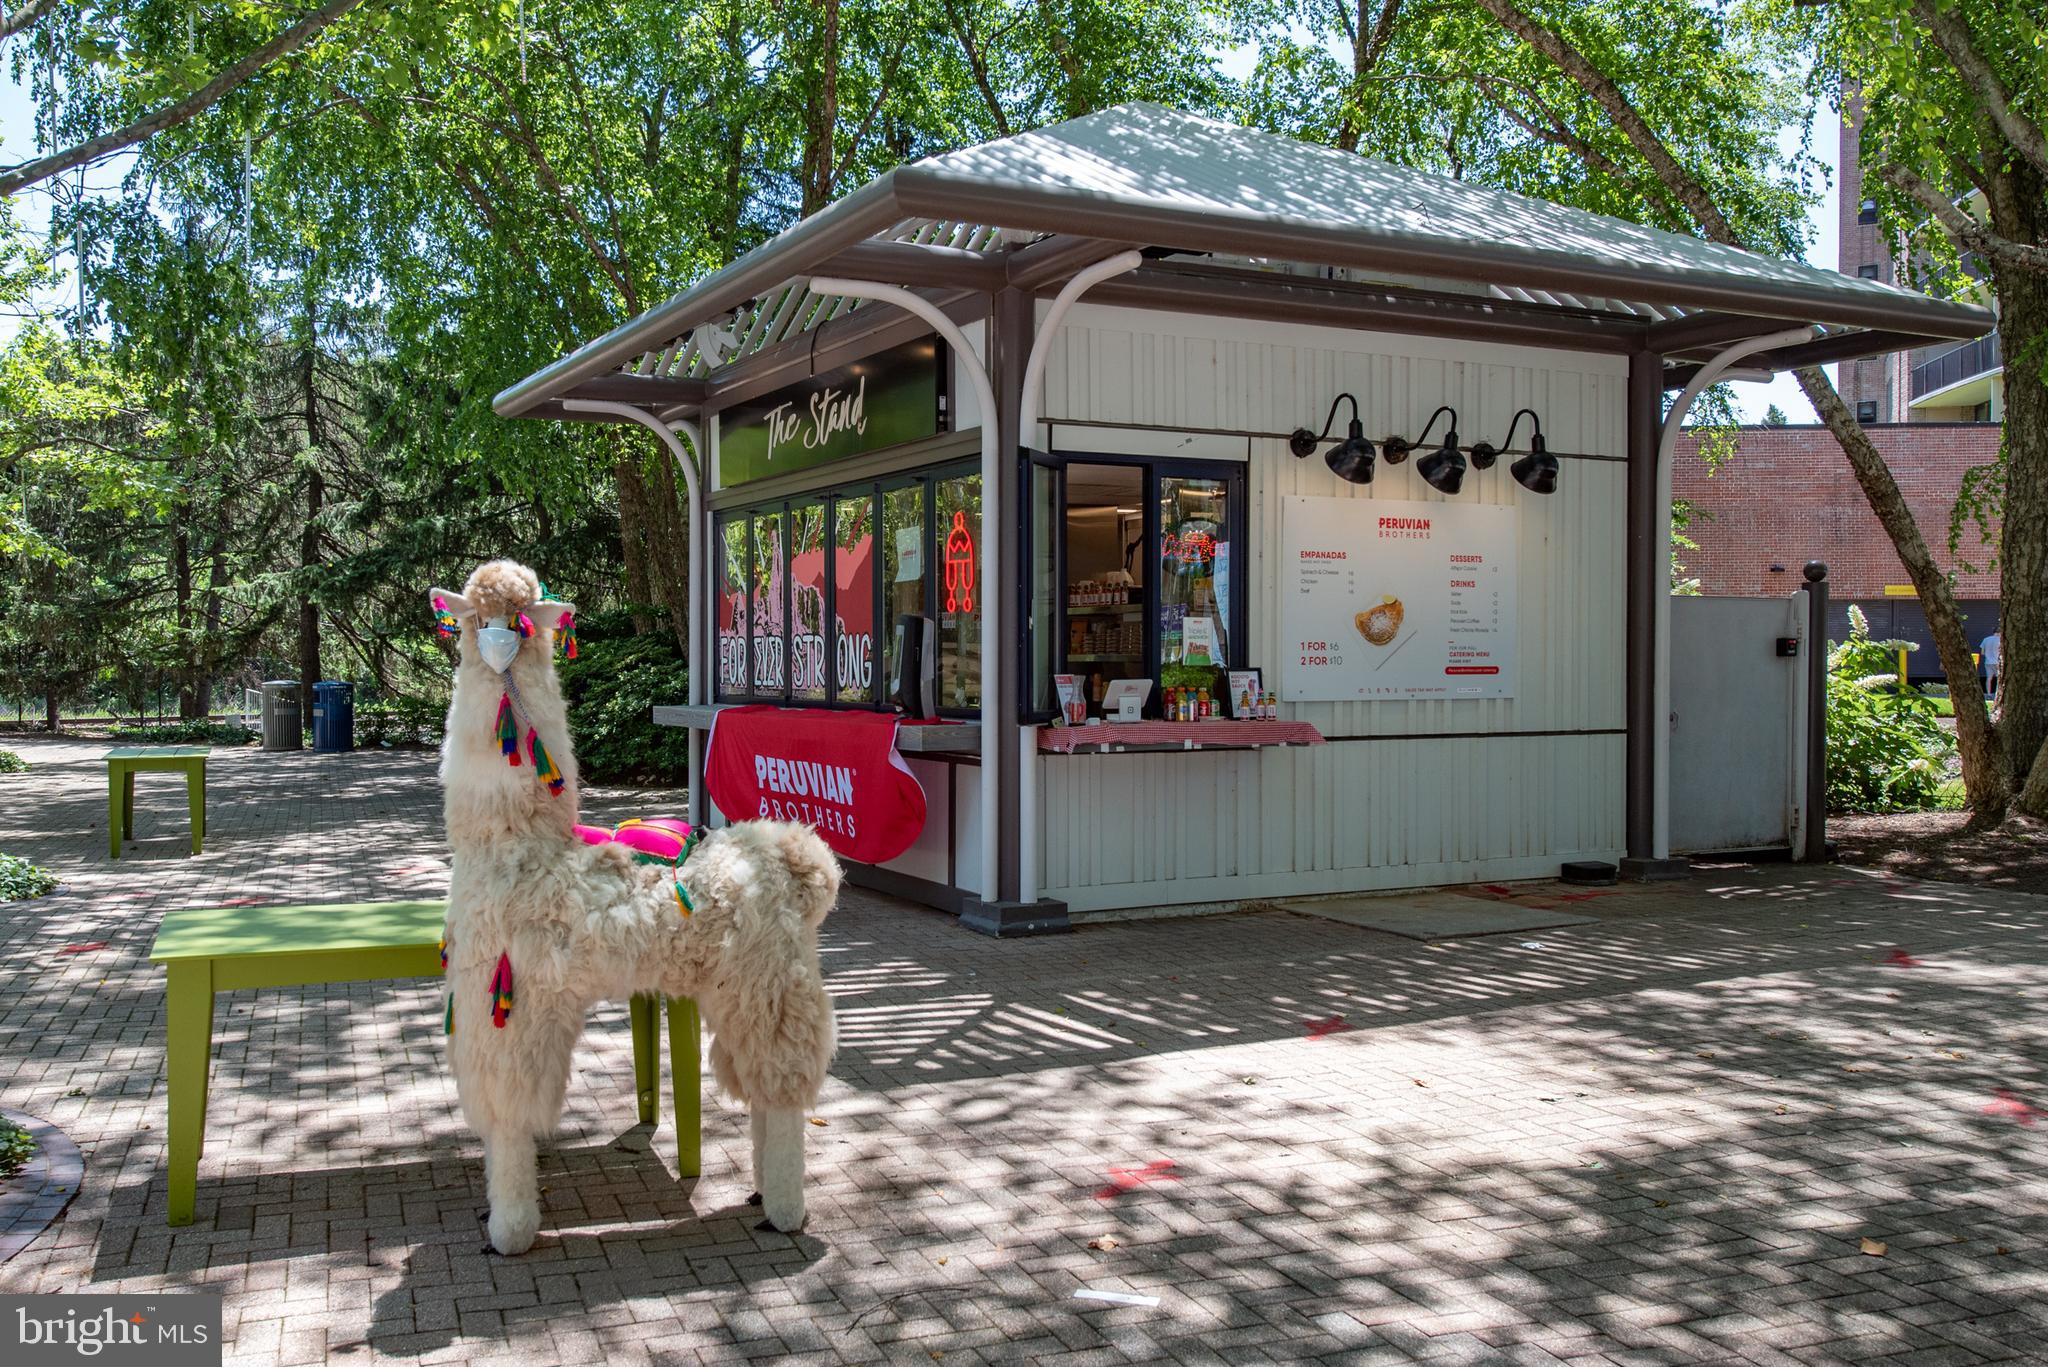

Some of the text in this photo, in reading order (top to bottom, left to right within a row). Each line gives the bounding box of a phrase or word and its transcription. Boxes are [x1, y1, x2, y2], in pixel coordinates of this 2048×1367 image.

[763, 375, 868, 460] The Stand
[1378, 517, 1430, 530] PERUVIAN
[1378, 530, 1431, 540] BROTHERS
[1300, 550, 1347, 560] EMPANADAS
[1450, 555, 1483, 564] DESSERTS
[1450, 580, 1476, 588] DRINKS
[1300, 641, 1340, 651] 1 FOR $6
[1300, 655, 1343, 666] 2 FOR $10
[754, 754, 854, 806] PERUVIAN
[758, 796, 857, 839] BROTHERS
